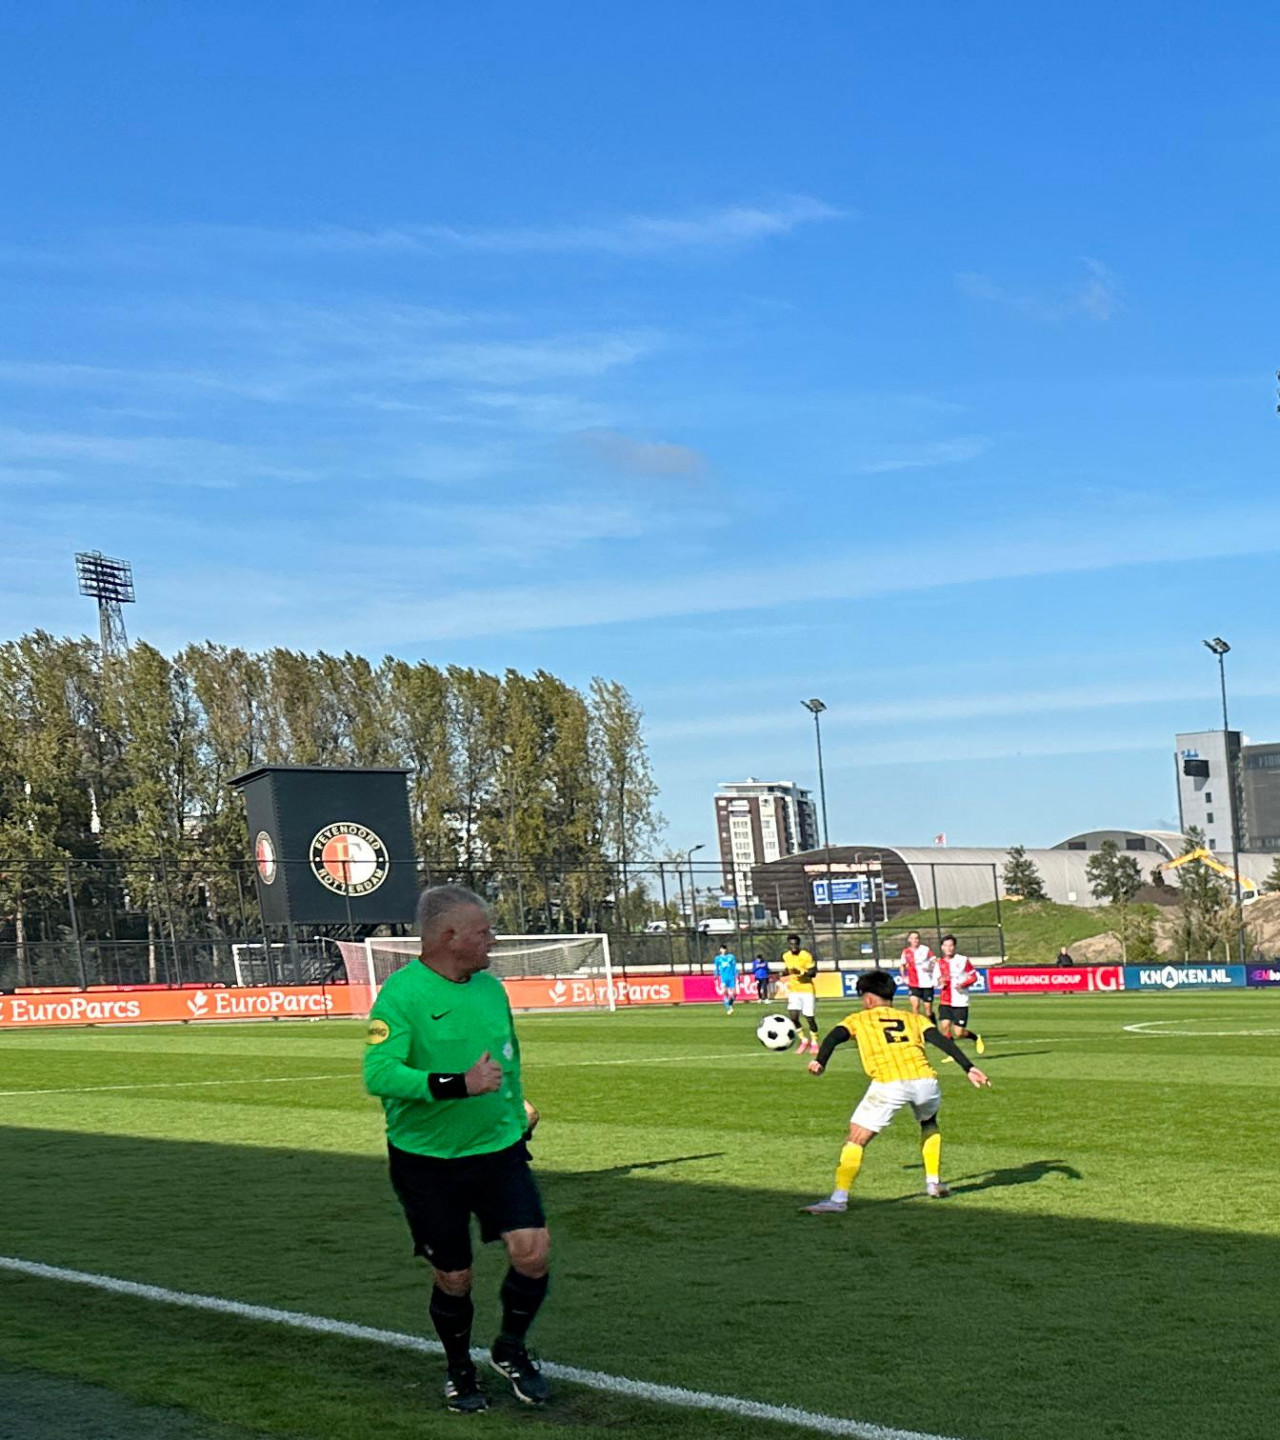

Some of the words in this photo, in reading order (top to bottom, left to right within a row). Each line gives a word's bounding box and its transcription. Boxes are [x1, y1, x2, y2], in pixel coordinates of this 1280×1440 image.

[315, 825, 381, 850] FEYENOORD
[992, 974, 1050, 985] INTELLIGENCE
[1051, 974, 1082, 984] GROUP
[1139, 966, 1232, 987] KNAKEN.NL
[10, 998, 141, 1021] EuroParcs
[214, 991, 333, 1014] EuroParcs
[879, 1018, 910, 1044] 2
